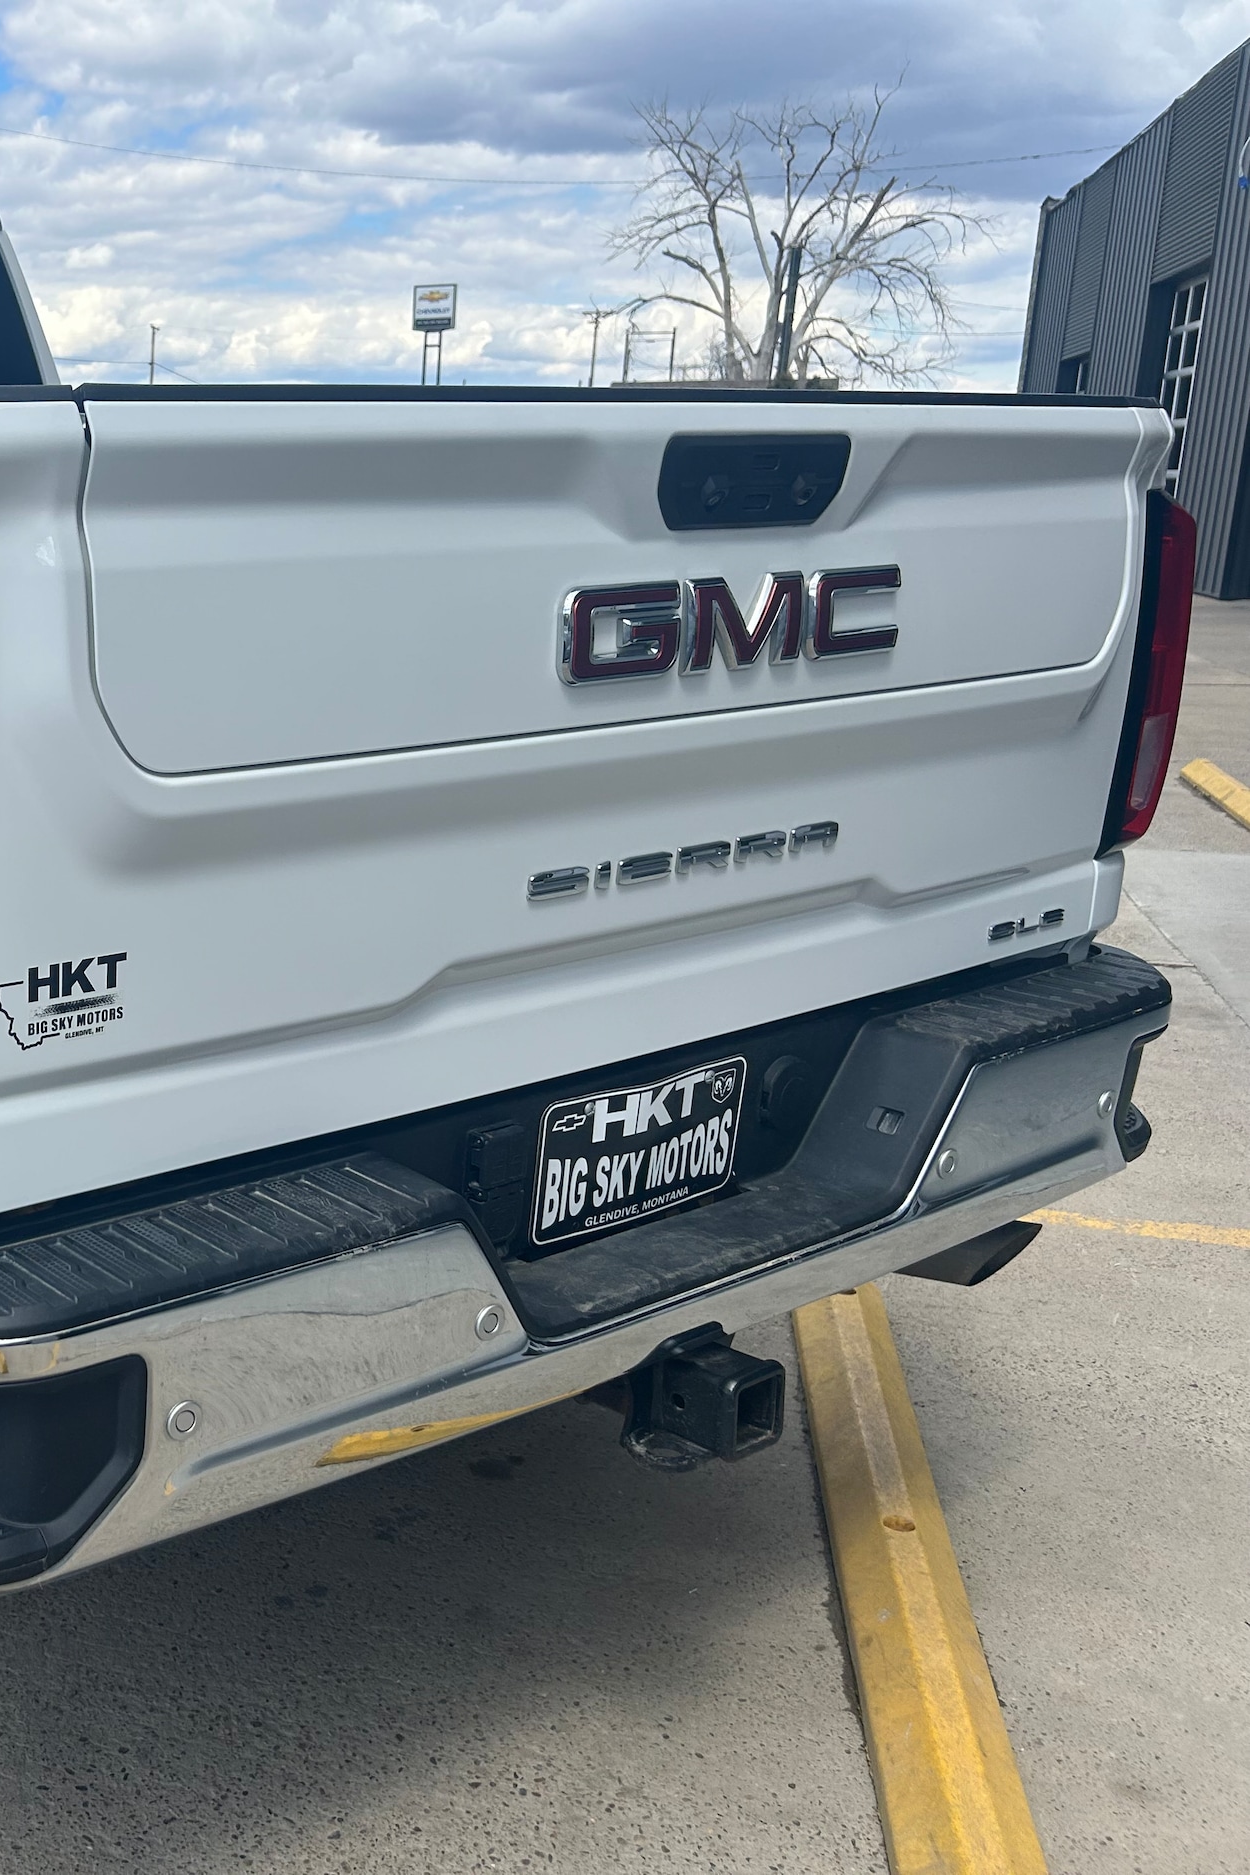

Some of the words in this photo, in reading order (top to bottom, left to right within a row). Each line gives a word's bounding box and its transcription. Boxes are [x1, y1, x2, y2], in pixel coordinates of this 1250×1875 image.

[556, 564, 902, 686] GMC
[526, 820, 839, 900] SIERRA
[988, 908, 1065, 941] SLE
[28, 952, 127, 1003] HKT
[28, 1021, 48, 1036] BIG
[51, 1015, 73, 1031] SKY
[77, 1006, 124, 1027] MOTORS
[95, 1025, 105, 1033] MT
[592, 1071, 707, 1143] HKT
[541, 1157, 588, 1230] BIG
[592, 1149, 645, 1208] SKY
[645, 1108, 733, 1190] MOTORS
[584, 1203, 640, 1227] GLENDIVE,
[641, 1185, 689, 1211] MONTANA
